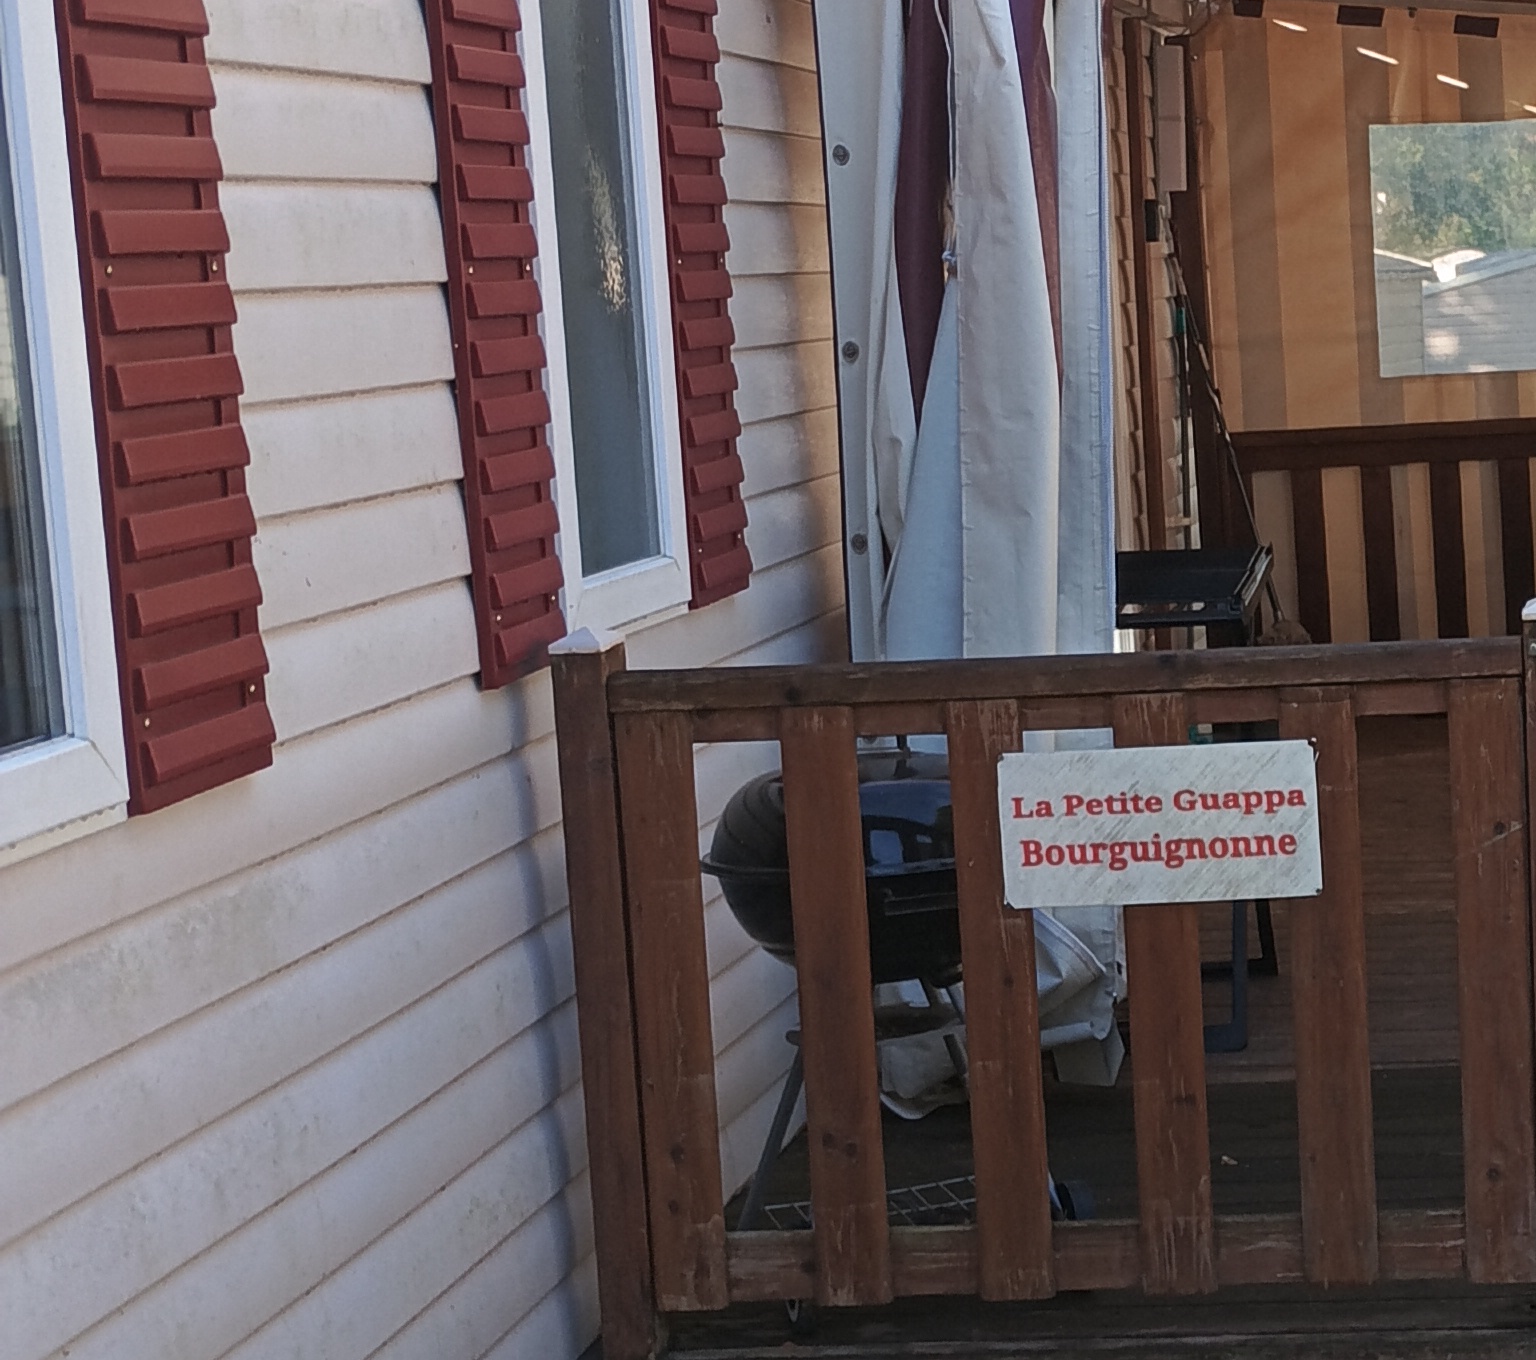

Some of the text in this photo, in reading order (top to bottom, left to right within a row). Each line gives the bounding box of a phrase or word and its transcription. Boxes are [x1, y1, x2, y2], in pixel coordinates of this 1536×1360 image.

[1011, 789, 1307, 819] La Petite Guappa
[1019, 833, 1298, 871] Bourguignonne
